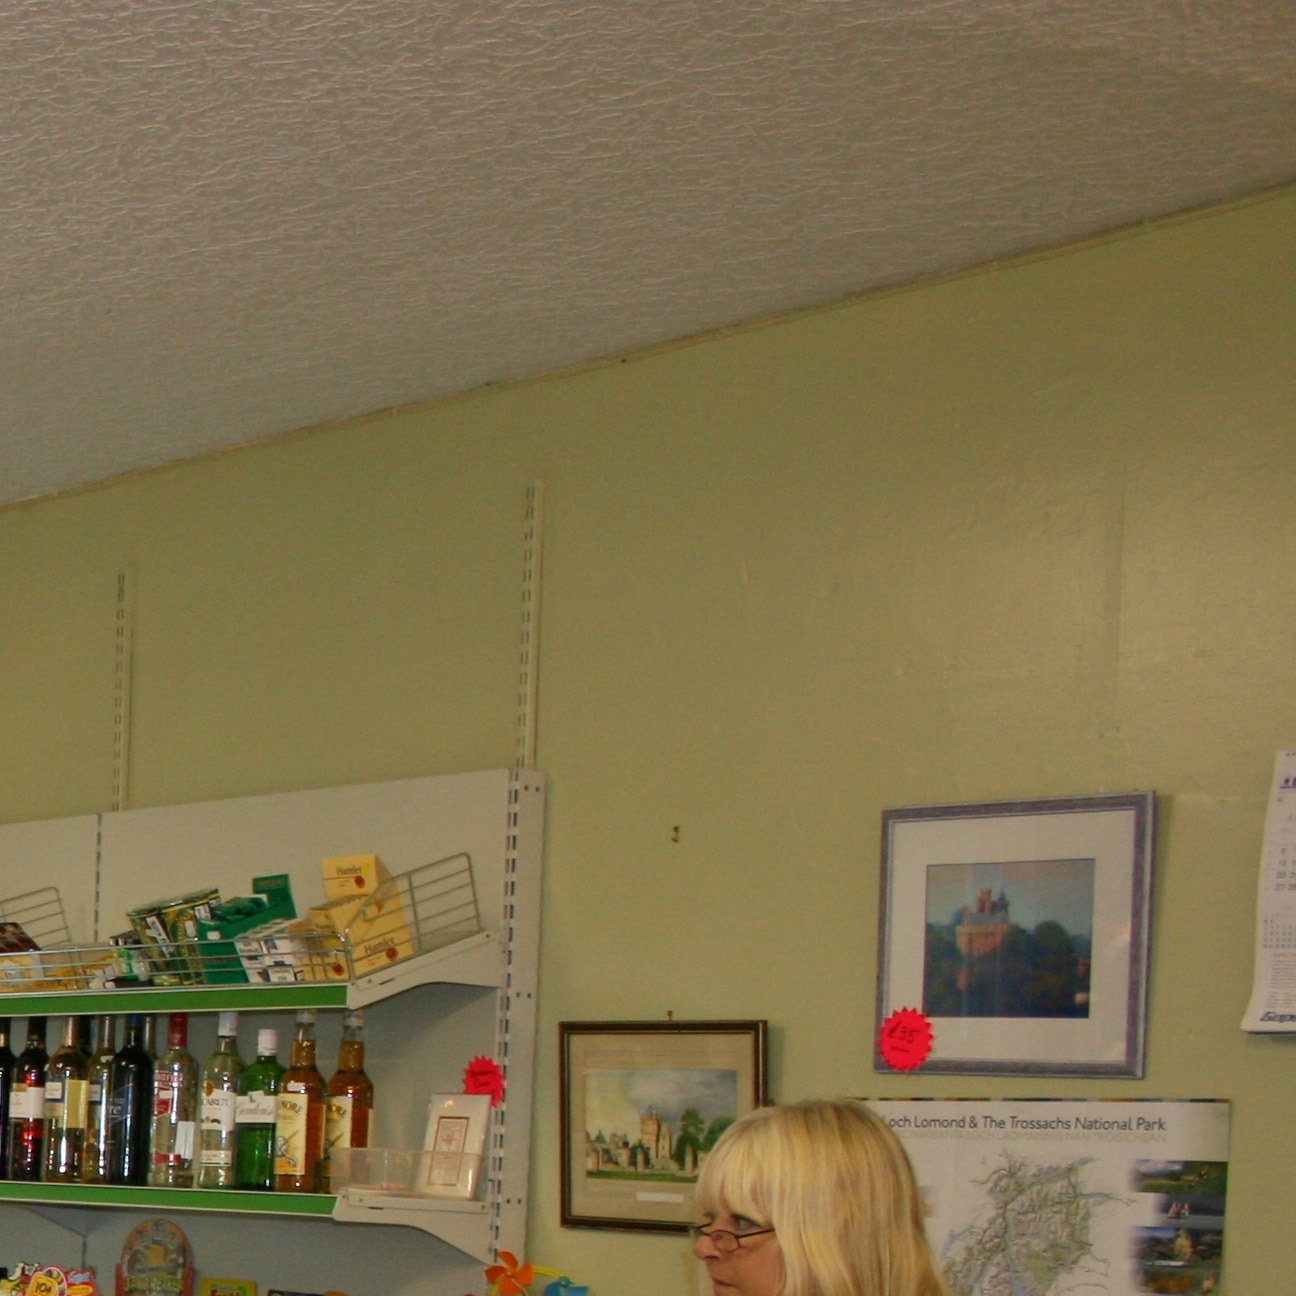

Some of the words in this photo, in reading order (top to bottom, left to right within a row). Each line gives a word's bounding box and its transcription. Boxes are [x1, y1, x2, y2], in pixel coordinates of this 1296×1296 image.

[914, 1115, 965, 1129] Lomond
[982, 1115, 1006, 1129] The
[1010, 1115, 1072, 1130] Trossachs
[1075, 1117, 1132, 1131] National
[1137, 1117, 1166, 1131] Park
